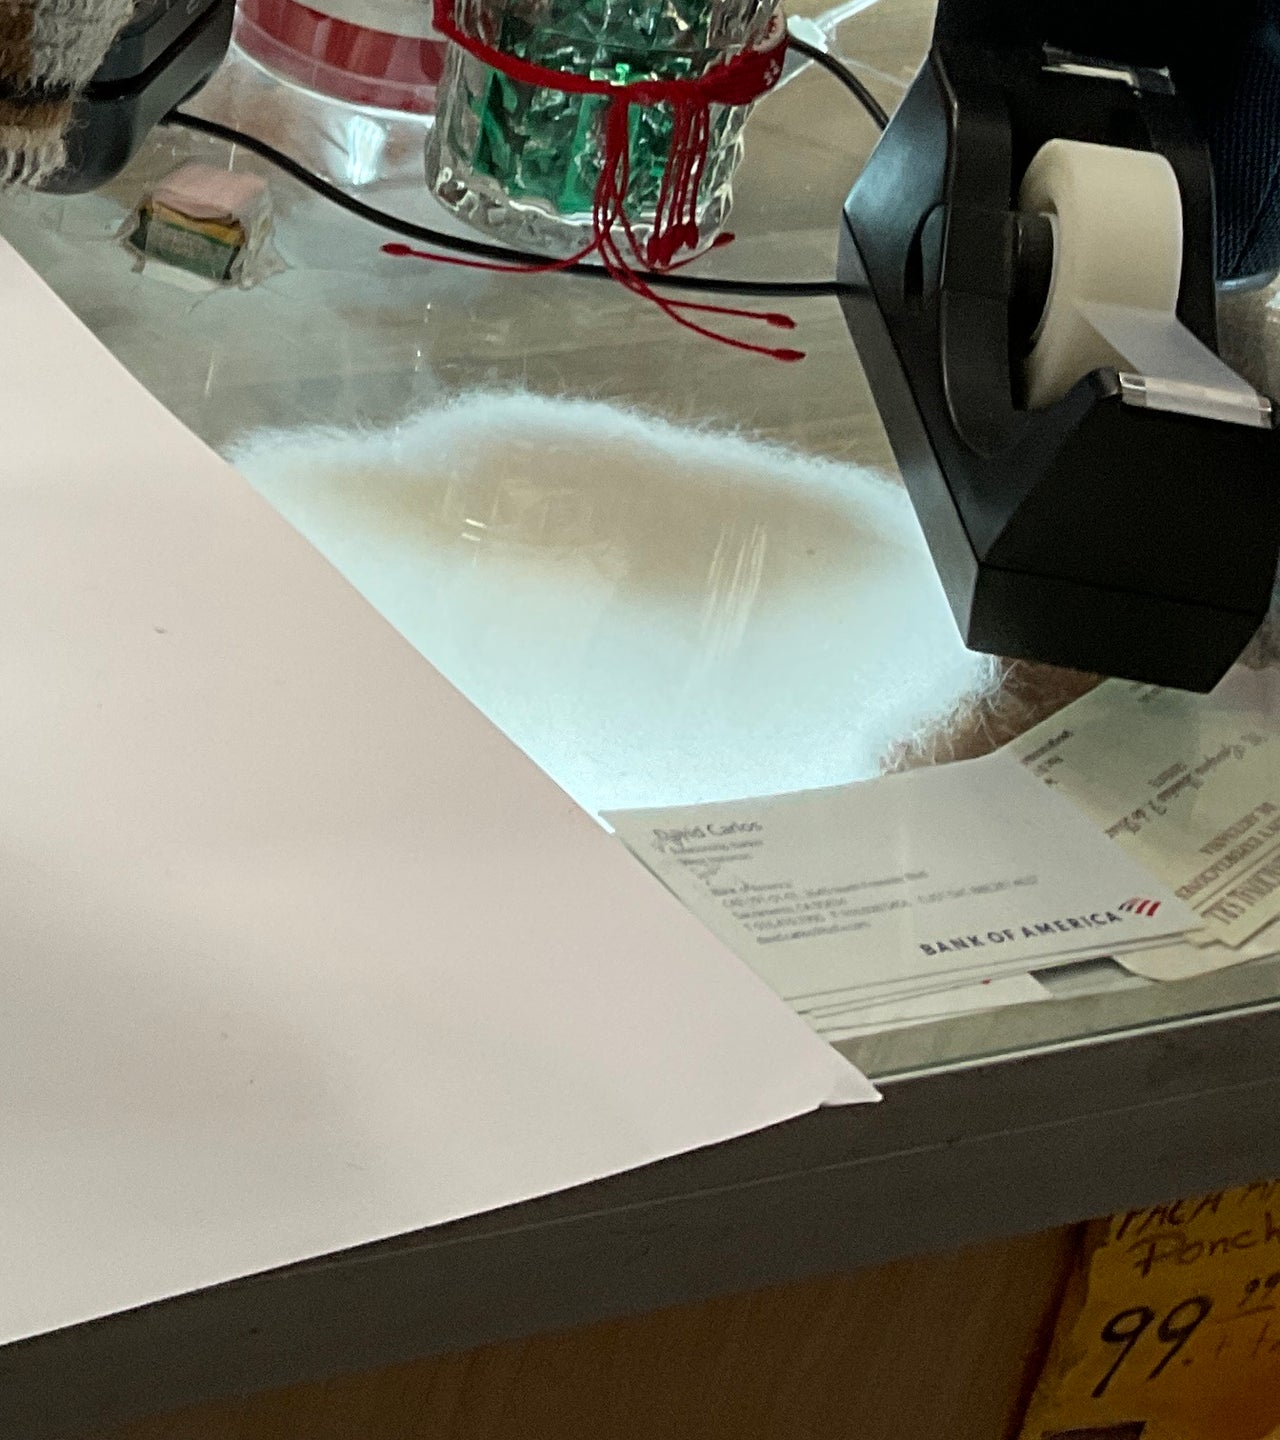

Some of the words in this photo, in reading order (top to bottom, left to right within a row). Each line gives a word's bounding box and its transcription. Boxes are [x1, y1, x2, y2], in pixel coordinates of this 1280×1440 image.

[920, 934, 985, 956] BANK
[987, 928, 1015, 944] OF
[1021, 910, 1123, 939] AMERICA
[1091, 1294, 1214, 1399] 99
